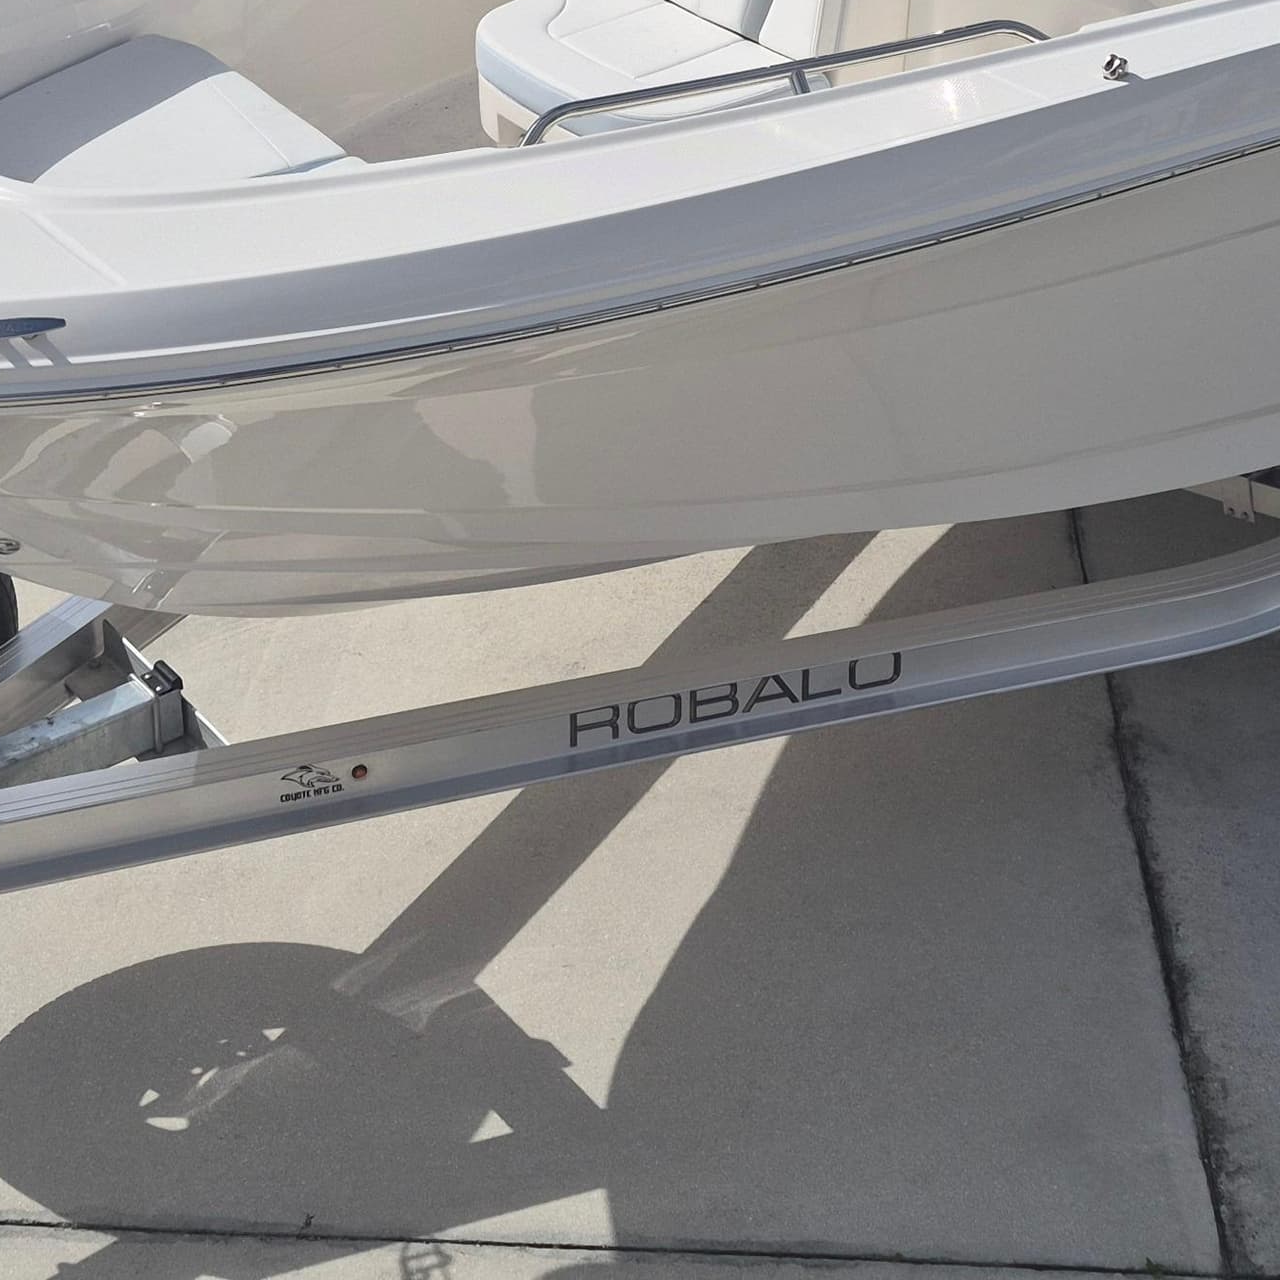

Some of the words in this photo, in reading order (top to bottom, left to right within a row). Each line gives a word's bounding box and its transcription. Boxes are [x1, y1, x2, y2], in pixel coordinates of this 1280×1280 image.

[570, 651, 903, 748] ROBALO
[280, 789, 312, 803] COYOTE
[313, 786, 330, 797] MFG
